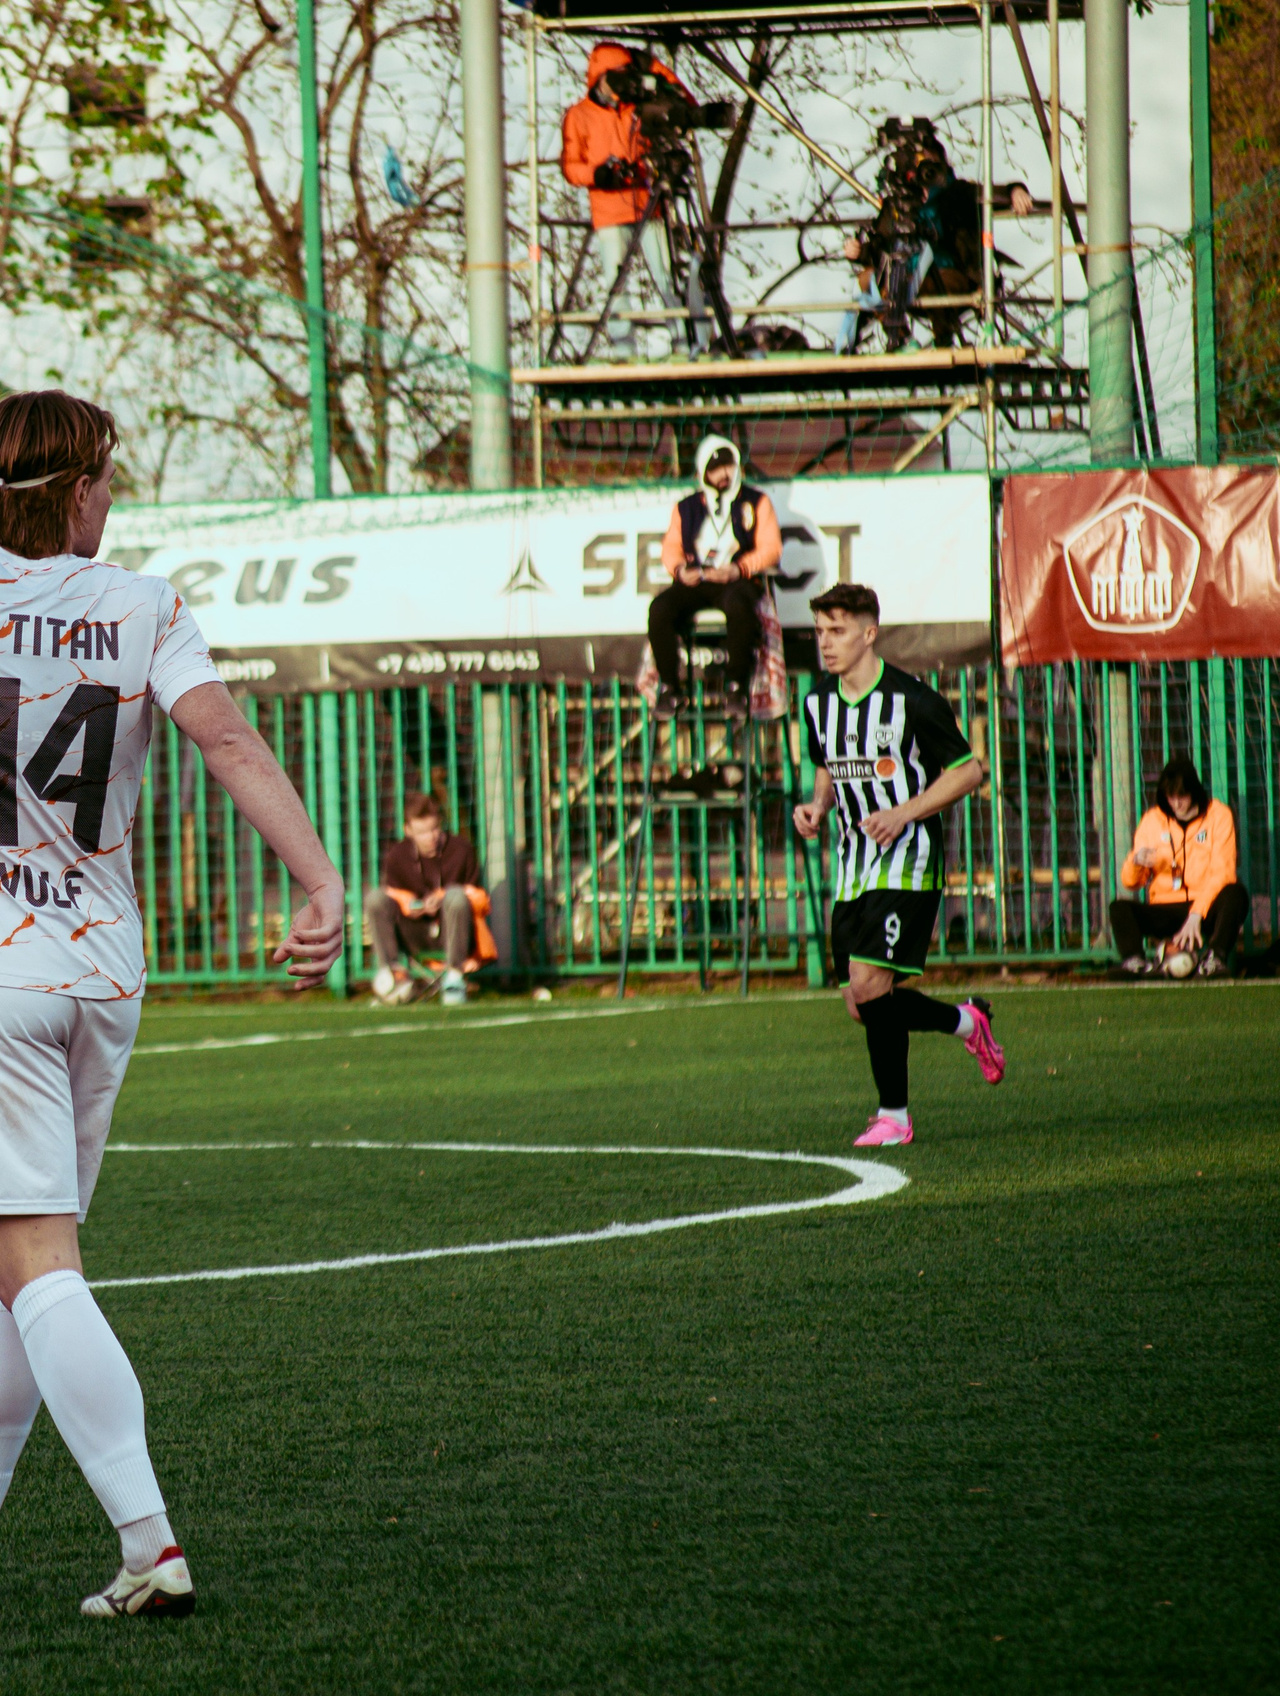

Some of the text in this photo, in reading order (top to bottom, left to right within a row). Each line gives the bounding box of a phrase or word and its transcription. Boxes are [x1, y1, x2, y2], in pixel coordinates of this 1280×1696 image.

[583, 524, 861, 598] SECT
[8, 612, 120, 661] TITAN
[448, 650, 486, 671] 777
[885, 911, 902, 948] 9
